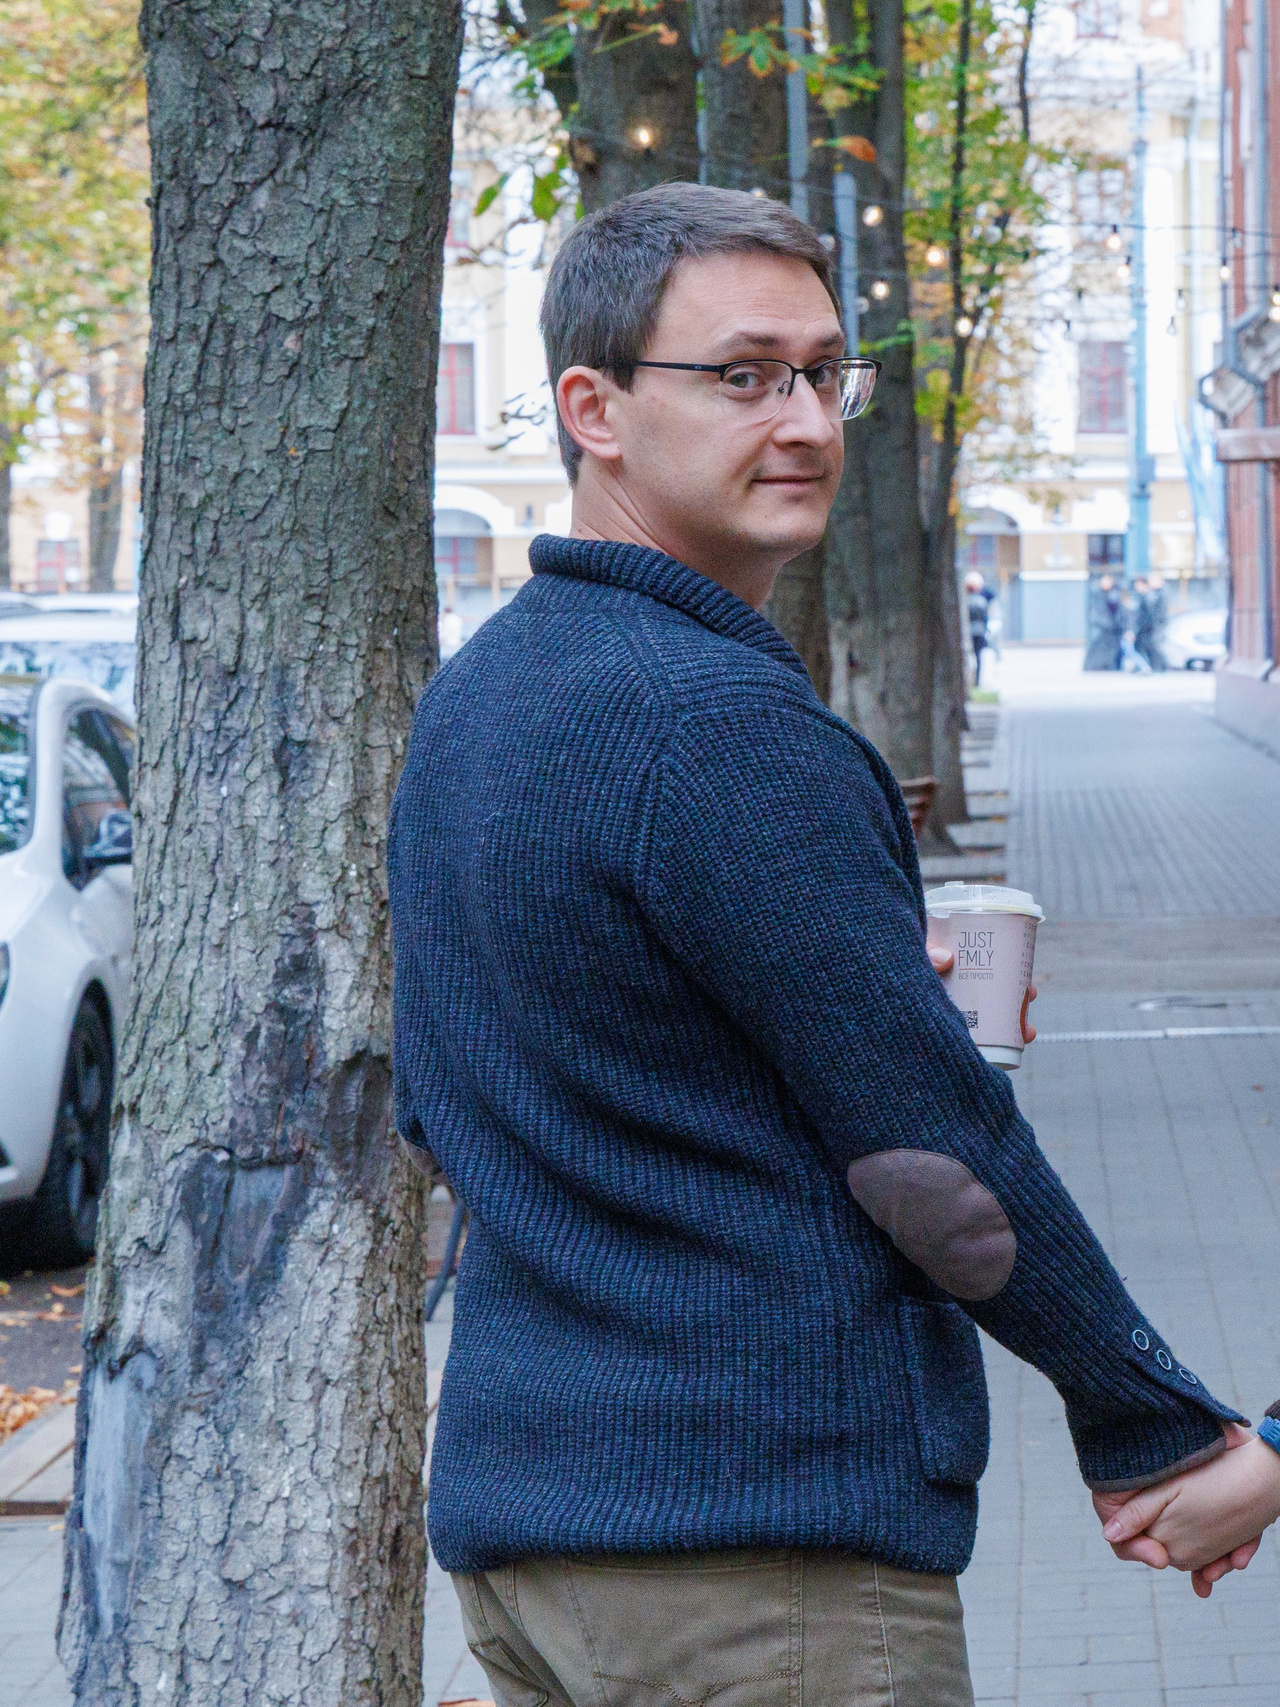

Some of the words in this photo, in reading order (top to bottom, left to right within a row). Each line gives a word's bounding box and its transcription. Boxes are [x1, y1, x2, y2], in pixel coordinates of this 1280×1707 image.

[958, 931, 995, 949] JUST
[958, 949, 995, 967] FMLY
[970, 972, 994, 980] ПРОСТО
